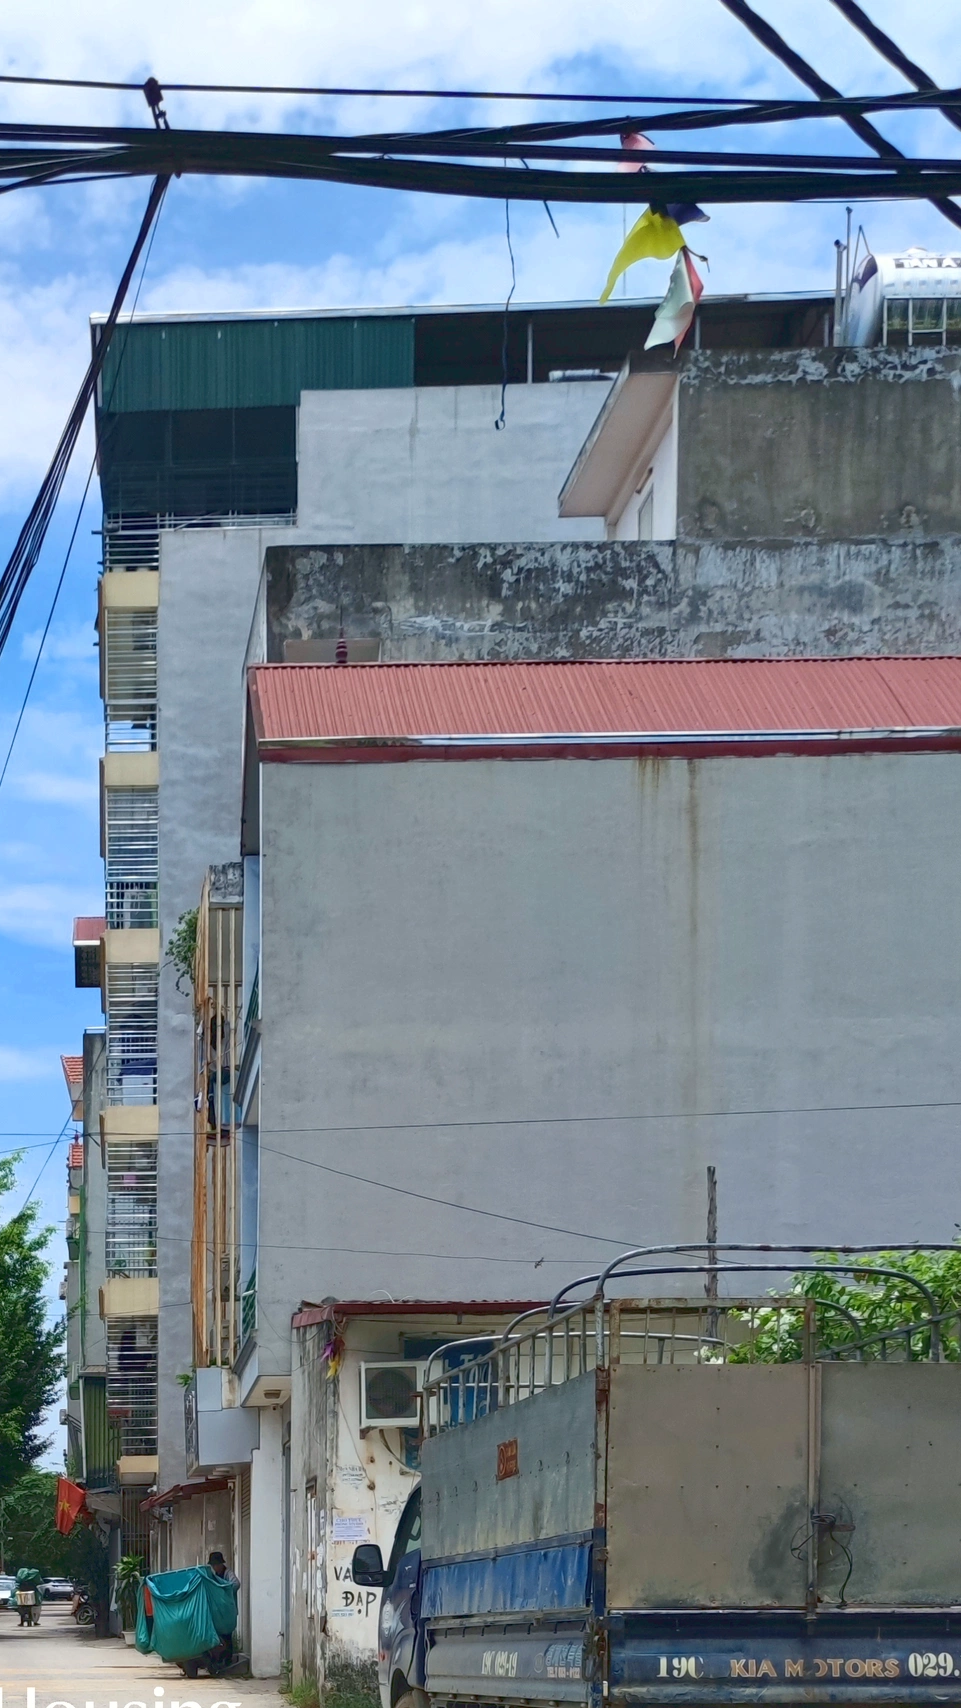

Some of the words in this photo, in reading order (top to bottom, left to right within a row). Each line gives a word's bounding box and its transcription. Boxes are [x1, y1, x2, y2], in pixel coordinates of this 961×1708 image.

[342, 1591, 377, 1618] ĐẠP
[656, 1656, 704, 1679] 19C
[730, 1659, 777, 1678] KIA
